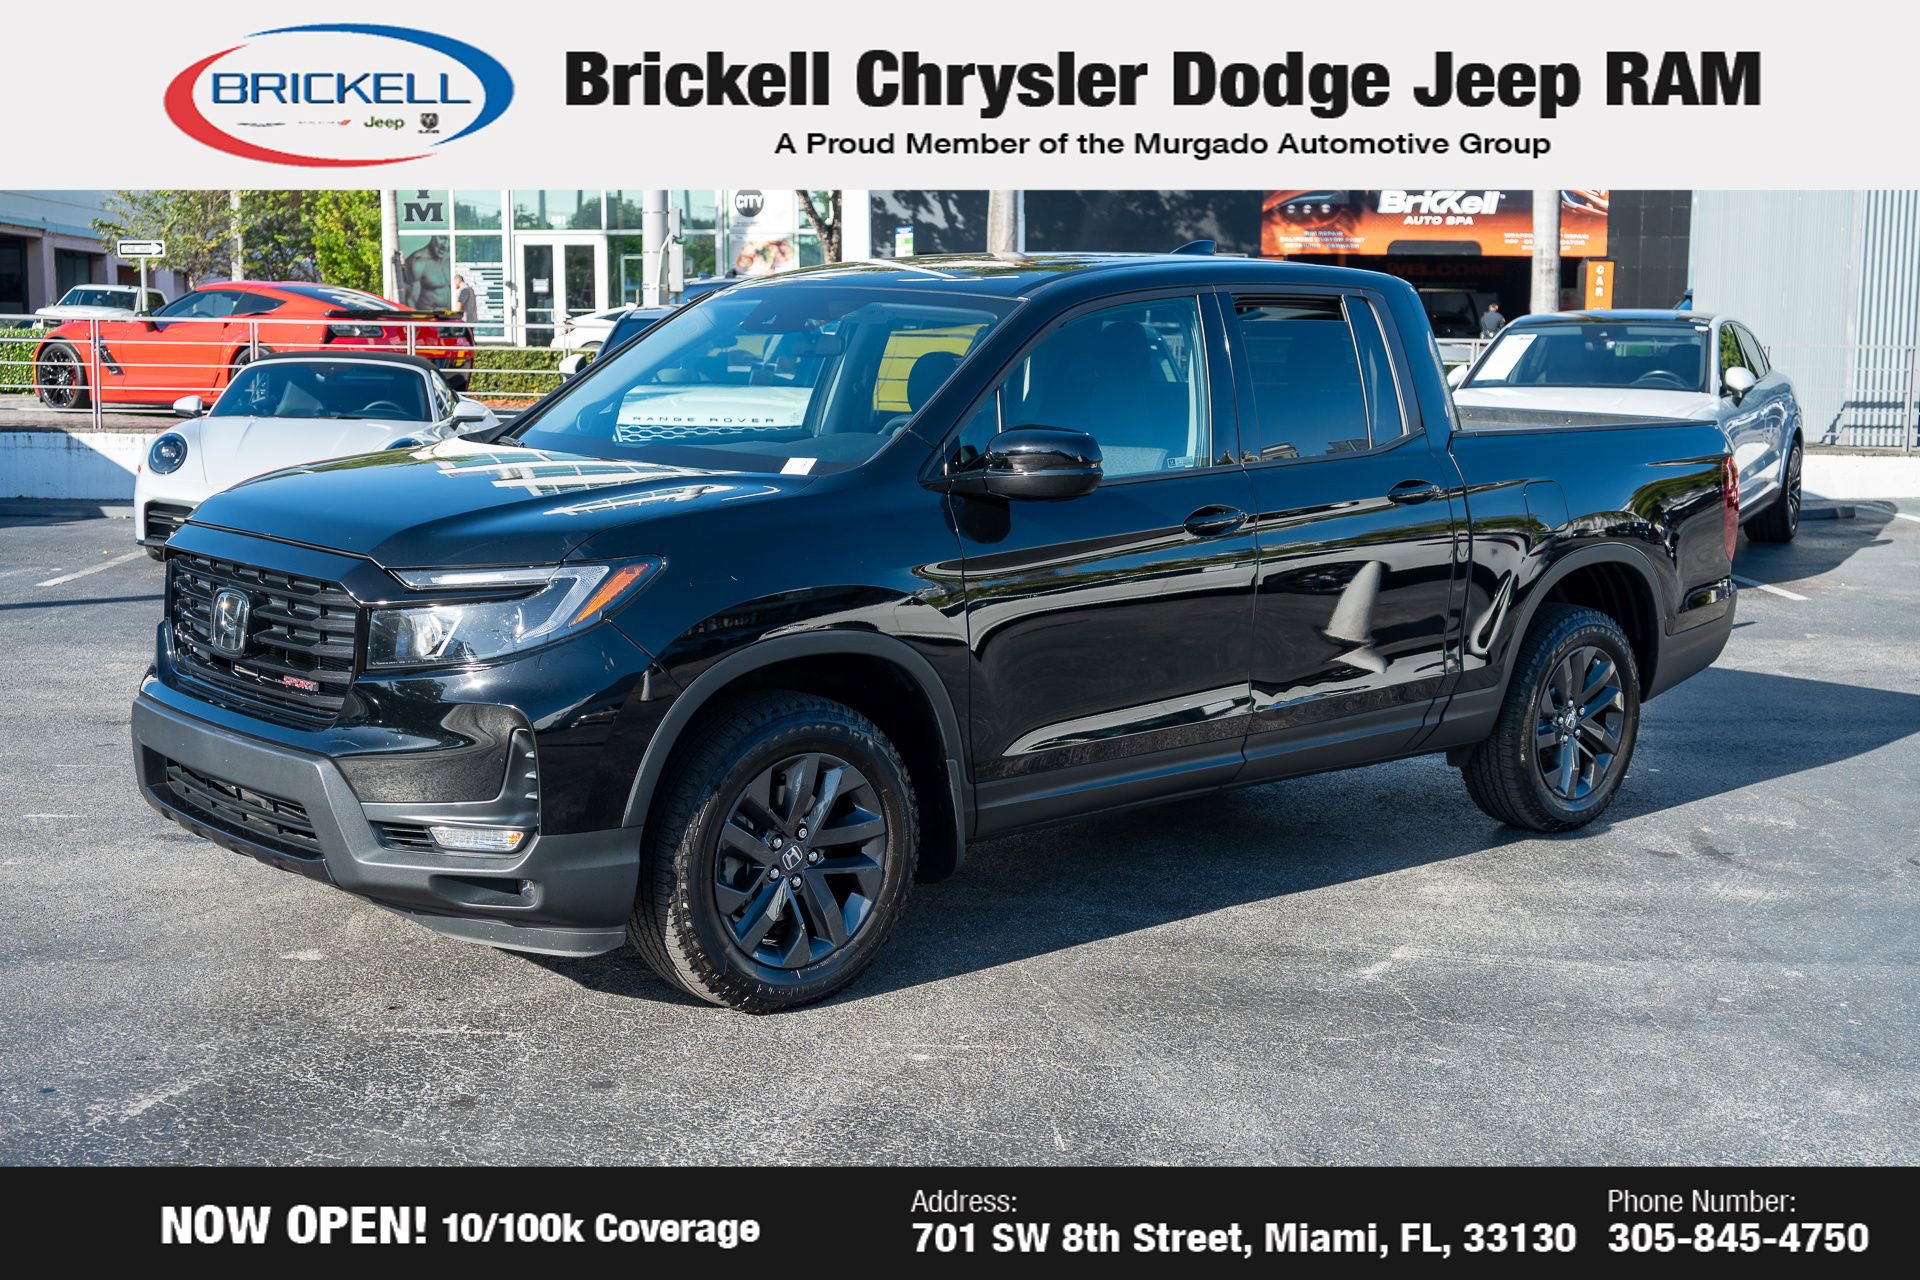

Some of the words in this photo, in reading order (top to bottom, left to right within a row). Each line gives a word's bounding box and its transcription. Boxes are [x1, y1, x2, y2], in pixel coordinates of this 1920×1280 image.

[736, 194, 763, 209] CITY
[1403, 215, 1443, 225] AUTO
[1445, 216, 1475, 226] SPA
[1595, 264, 1605, 297] CAR
[283, 675, 317, 692] SPORT
